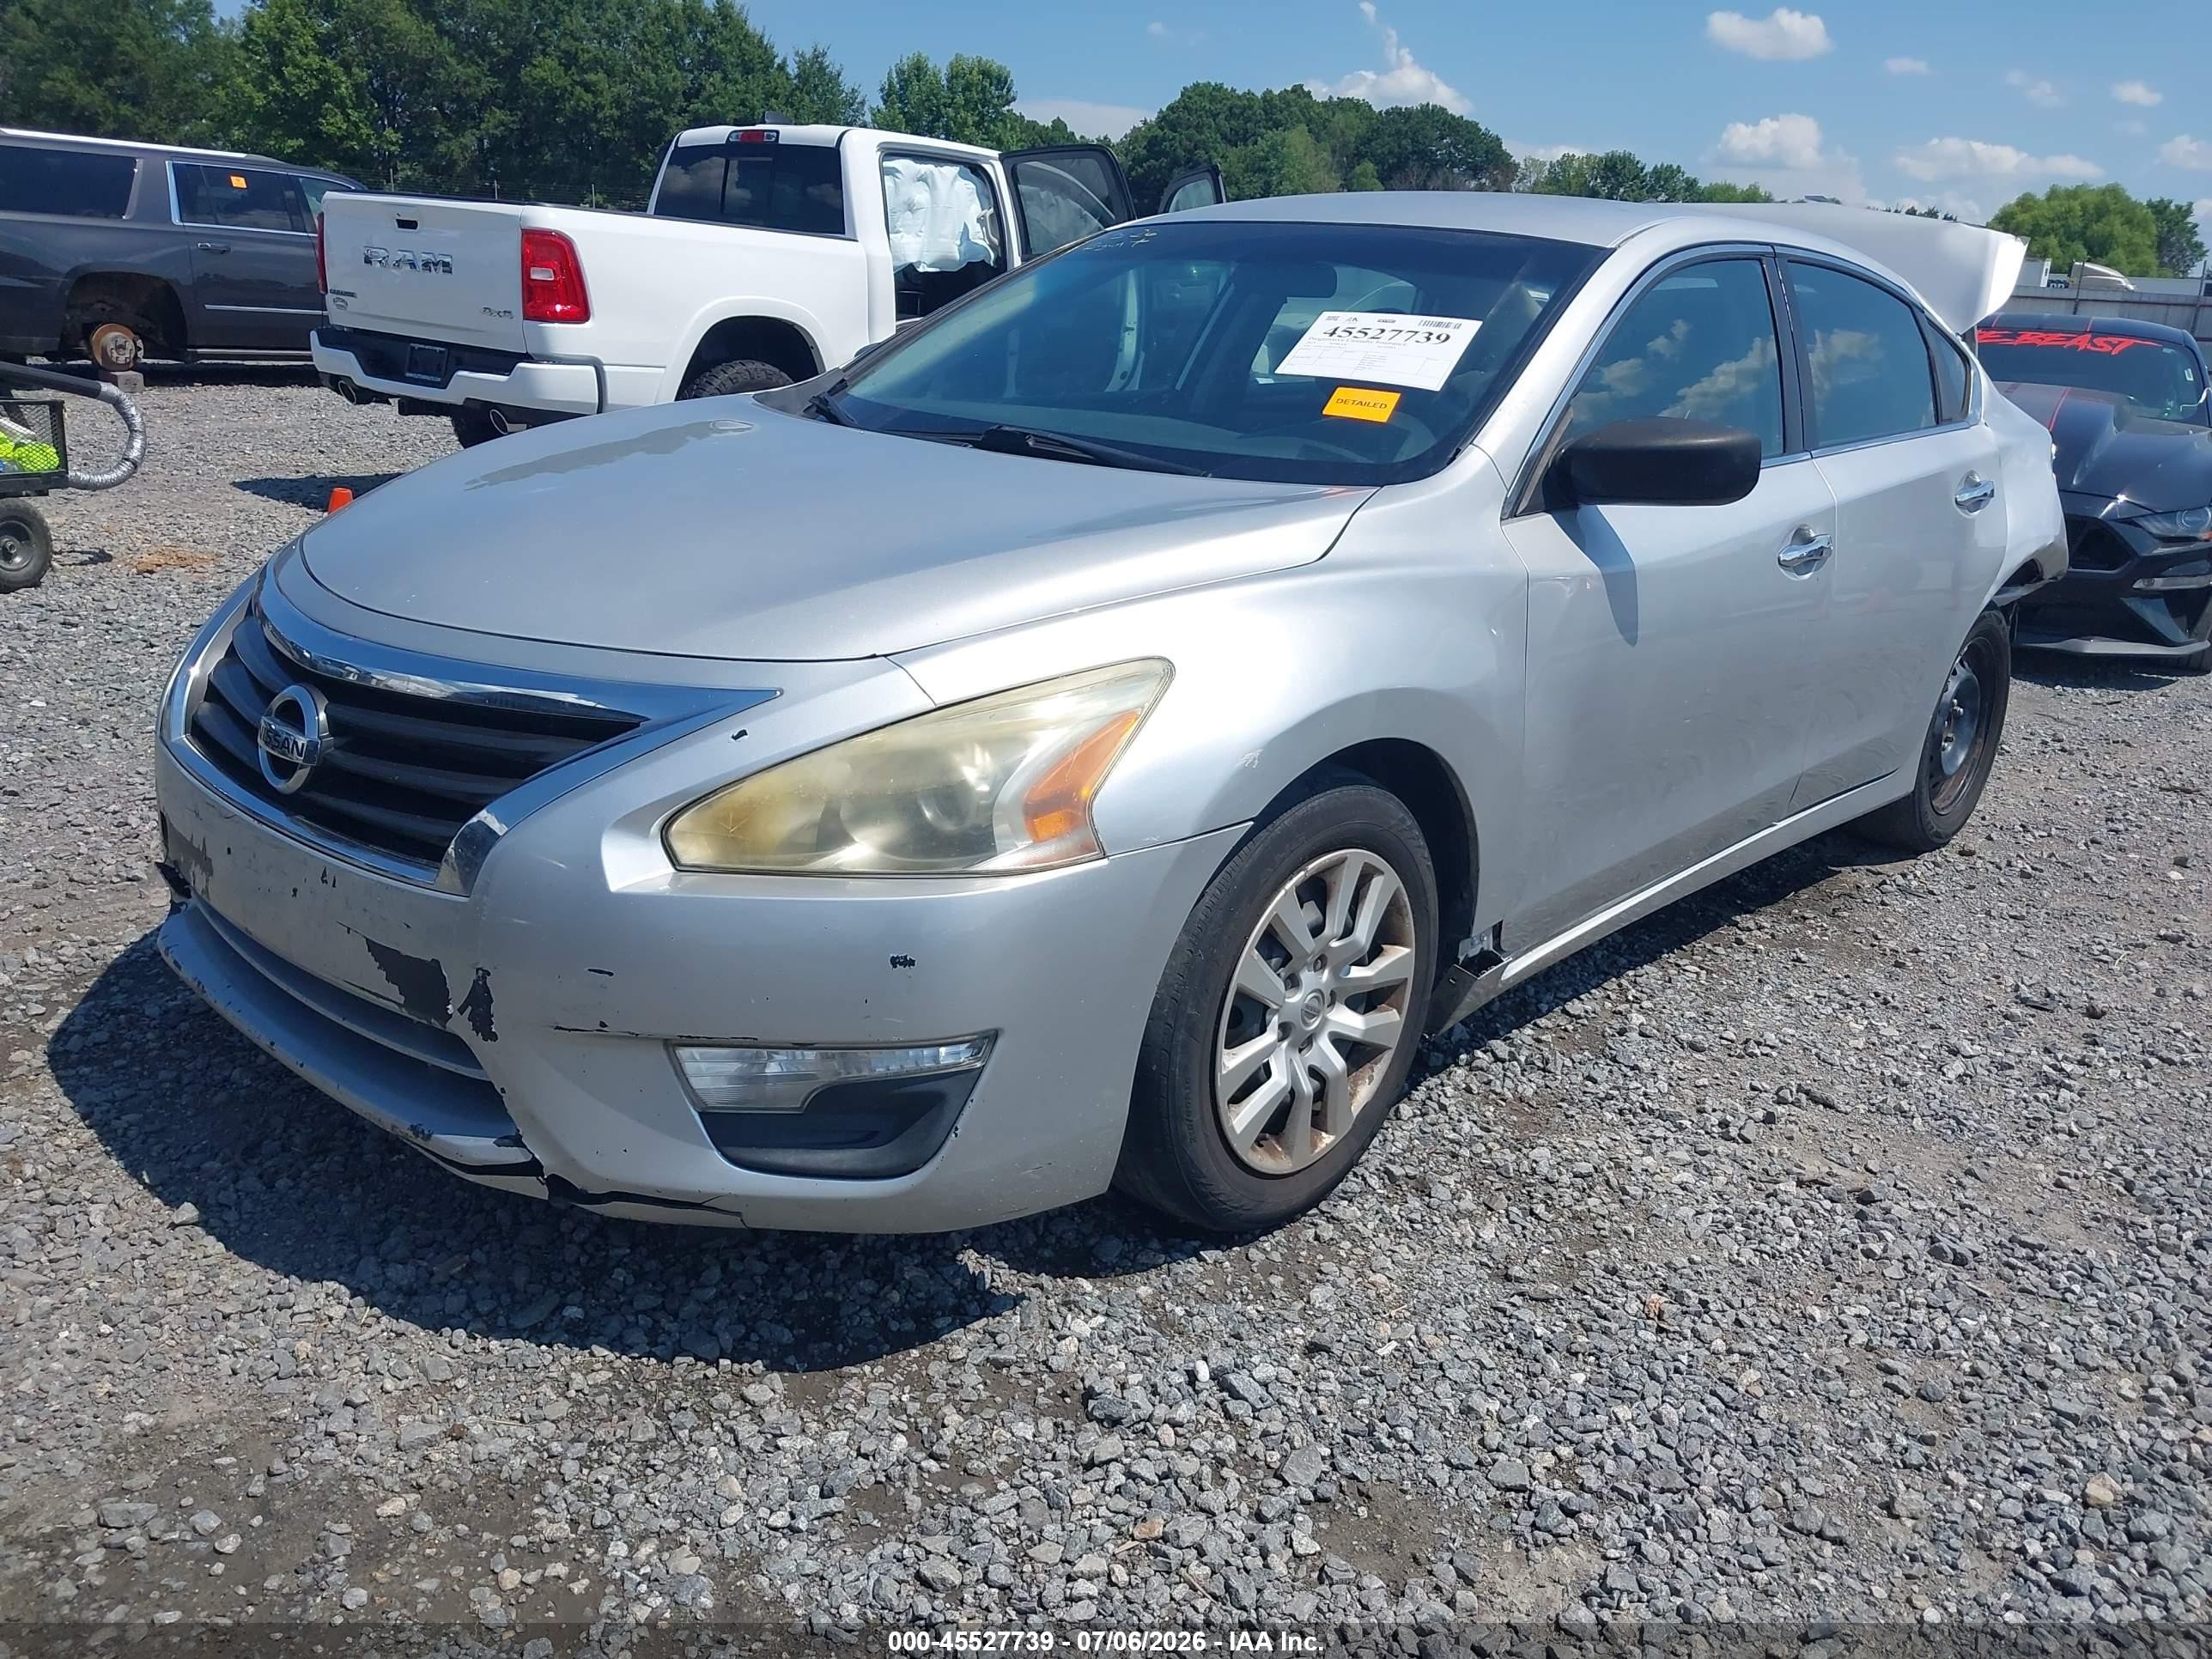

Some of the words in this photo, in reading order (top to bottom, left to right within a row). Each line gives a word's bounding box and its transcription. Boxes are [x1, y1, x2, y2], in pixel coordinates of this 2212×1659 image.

[363, 246, 453, 275] RAM
[1322, 325, 1451, 345] 45527739
[2013, 331, 2164, 356] BEAST
[1335, 398, 1388, 410] DETAILED
[259, 720, 305, 758] NISSAN
